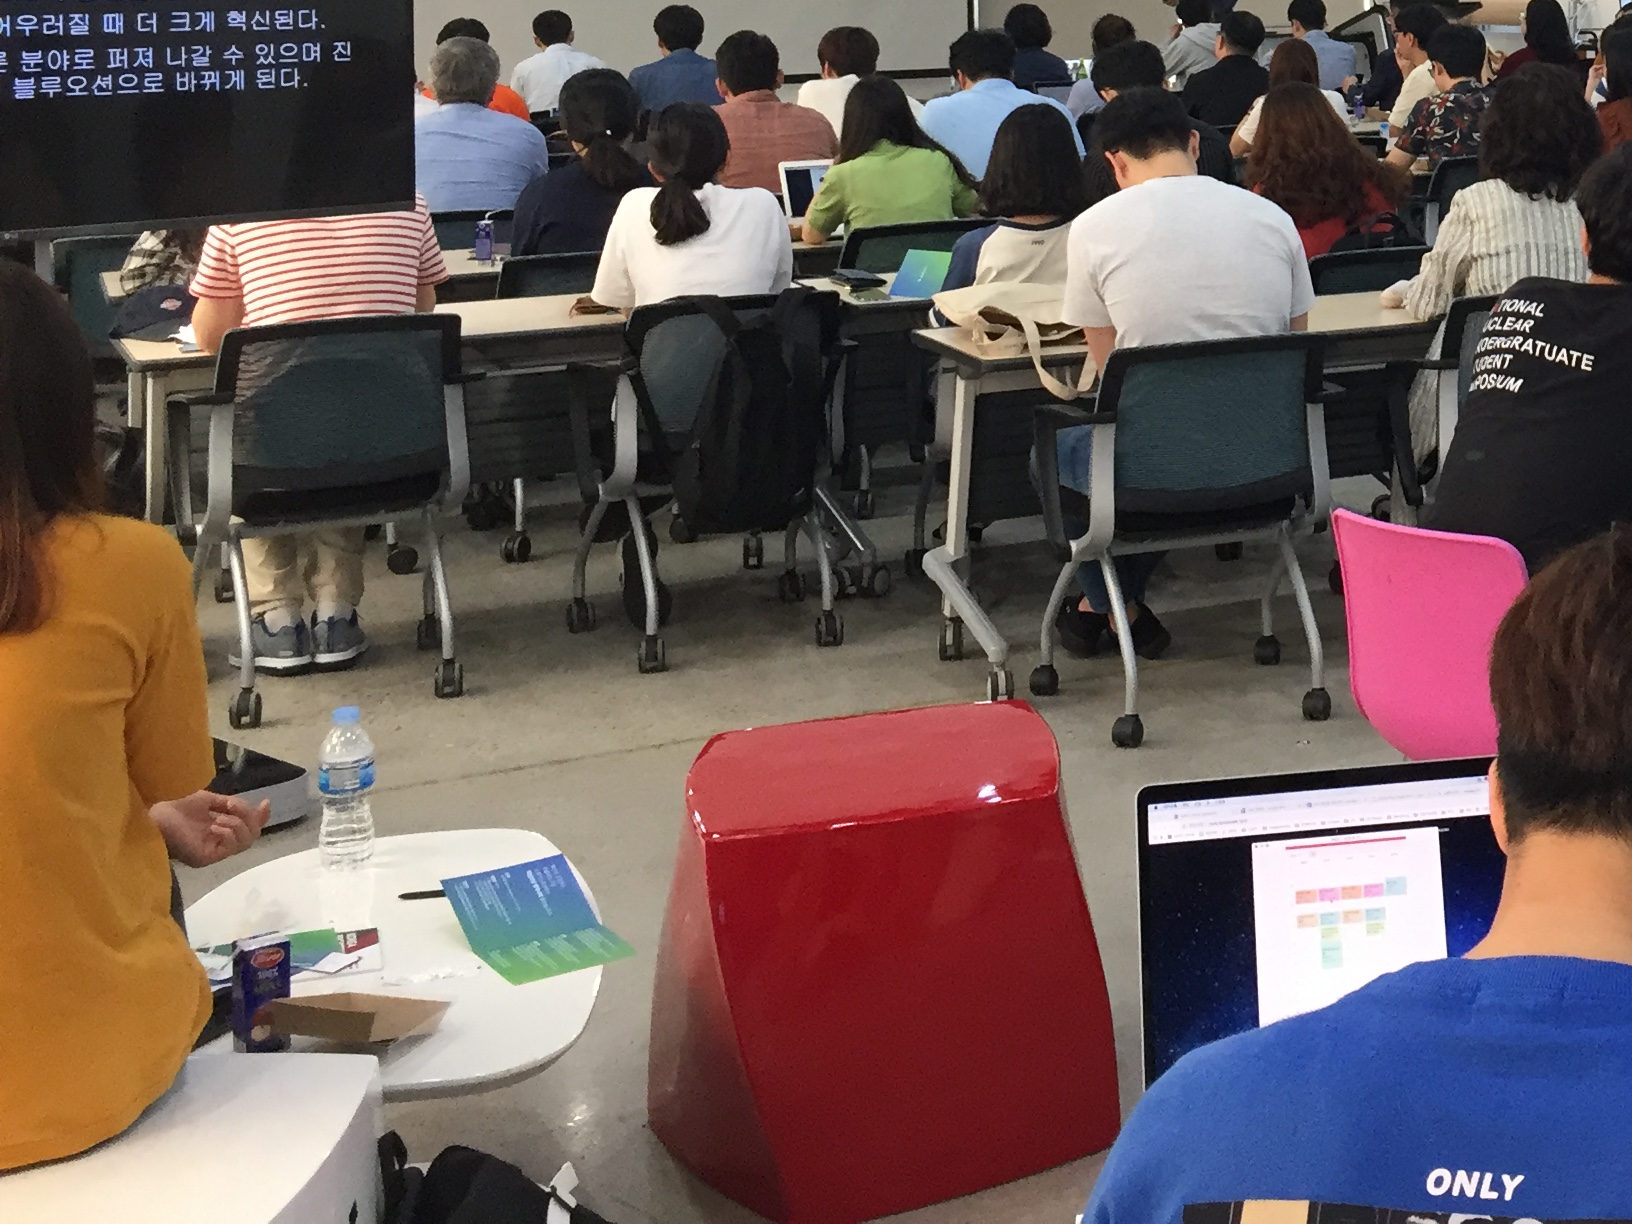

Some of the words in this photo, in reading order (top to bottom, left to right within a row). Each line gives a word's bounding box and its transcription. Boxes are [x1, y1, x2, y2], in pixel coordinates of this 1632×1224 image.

[103, 12, 125, 35] 때
[137, 12, 158, 34] 더
[169, 11, 216, 33] 크게
[227, 9, 326, 31] 혁신된다.
[20, 49, 96, 73] 분야로
[107, 46, 154, 70] 퍼져
[166, 45, 212, 67] 나갈
[223, 44, 245, 65] 수
[255, 42, 322, 65] 있으며
[332, 40, 352, 62] 진
[13, 72, 165, 100] 블루오션으로
[176, 69, 246, 93] 바뀌게
[256, 67, 308, 89] 된다.
[1493, 298, 1545, 317] TIONAL
[1426, 1167, 1525, 1201] ONLY
